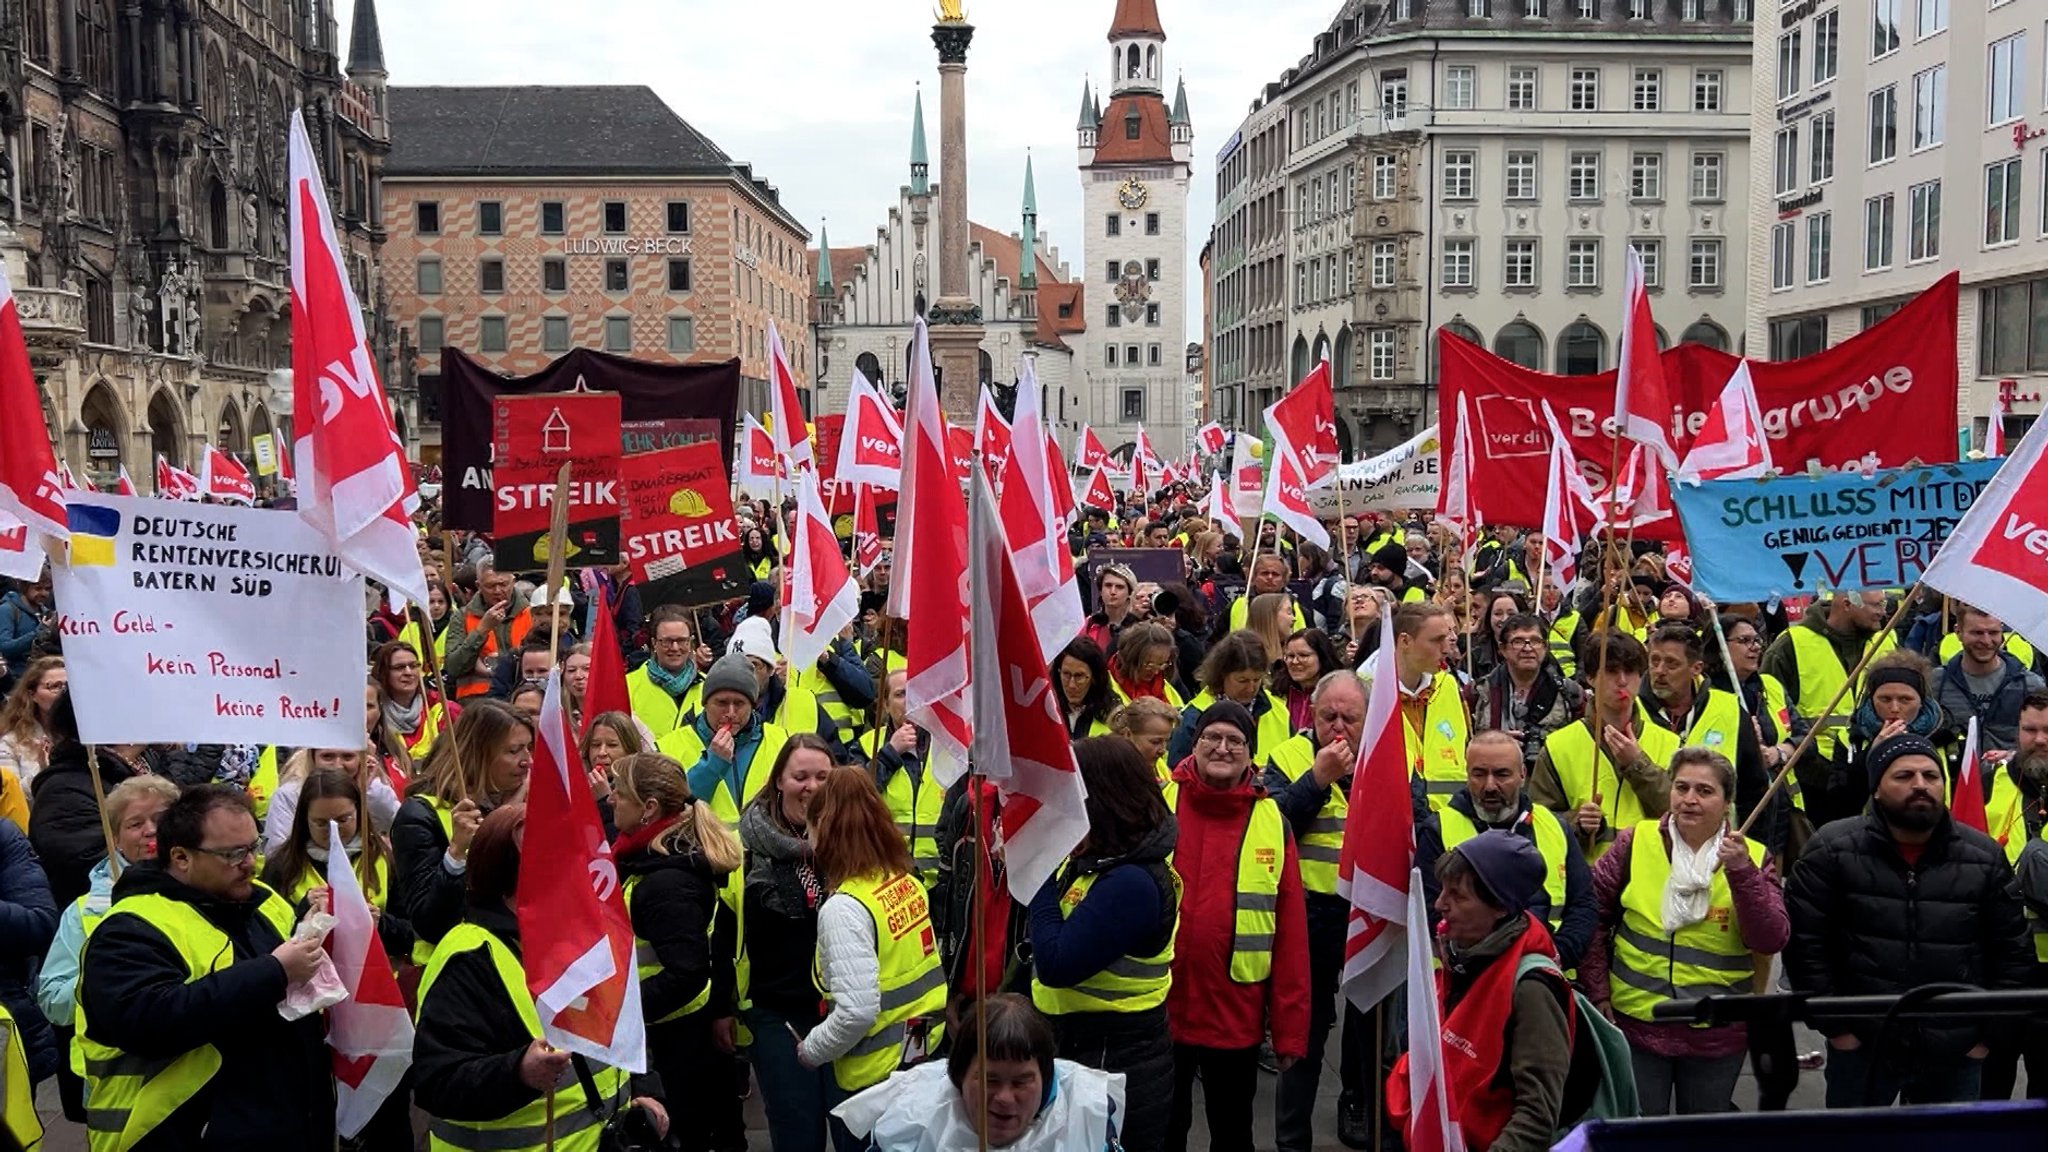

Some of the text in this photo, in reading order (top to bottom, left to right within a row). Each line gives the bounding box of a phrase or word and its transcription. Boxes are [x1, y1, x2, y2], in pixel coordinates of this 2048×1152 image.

[564, 238, 693, 254] LUDWIG BECK
[461, 466, 494, 491] AN
[1413, 458, 1438, 476] BE
[498, 480, 618, 511] STREIK
[1721, 488, 1876, 527] SCHLUSS
[132, 516, 237, 541] DEUTSCHE
[628, 519, 737, 559] STREIK
[133, 571, 273, 597] BAYERN SÜD
[113, 610, 157, 634] Geld
[207, 651, 281, 679] Personal
